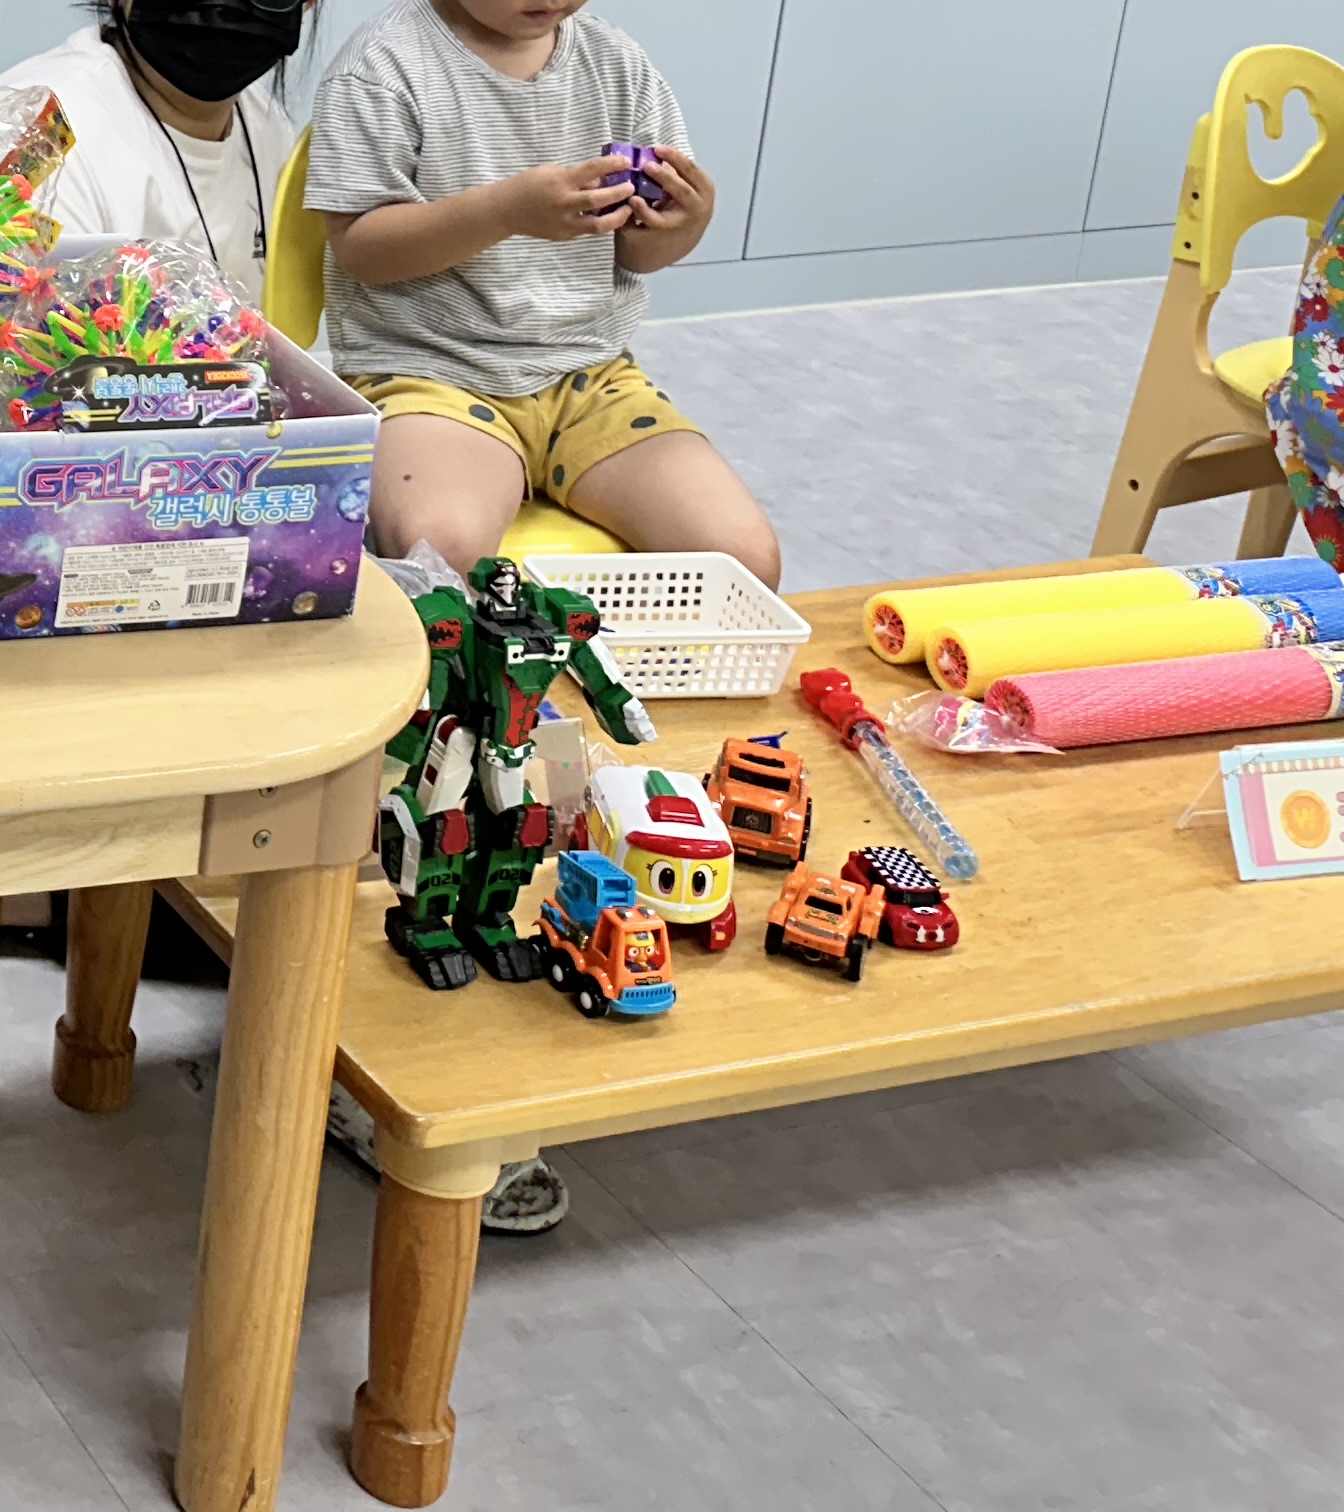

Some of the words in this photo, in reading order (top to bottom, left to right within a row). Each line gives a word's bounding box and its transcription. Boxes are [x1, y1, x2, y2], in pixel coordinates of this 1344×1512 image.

[20, 448, 281, 511] GALAXY
[150, 491, 233, 528] 갤럭시
[237, 485, 316, 525] 통통볼
